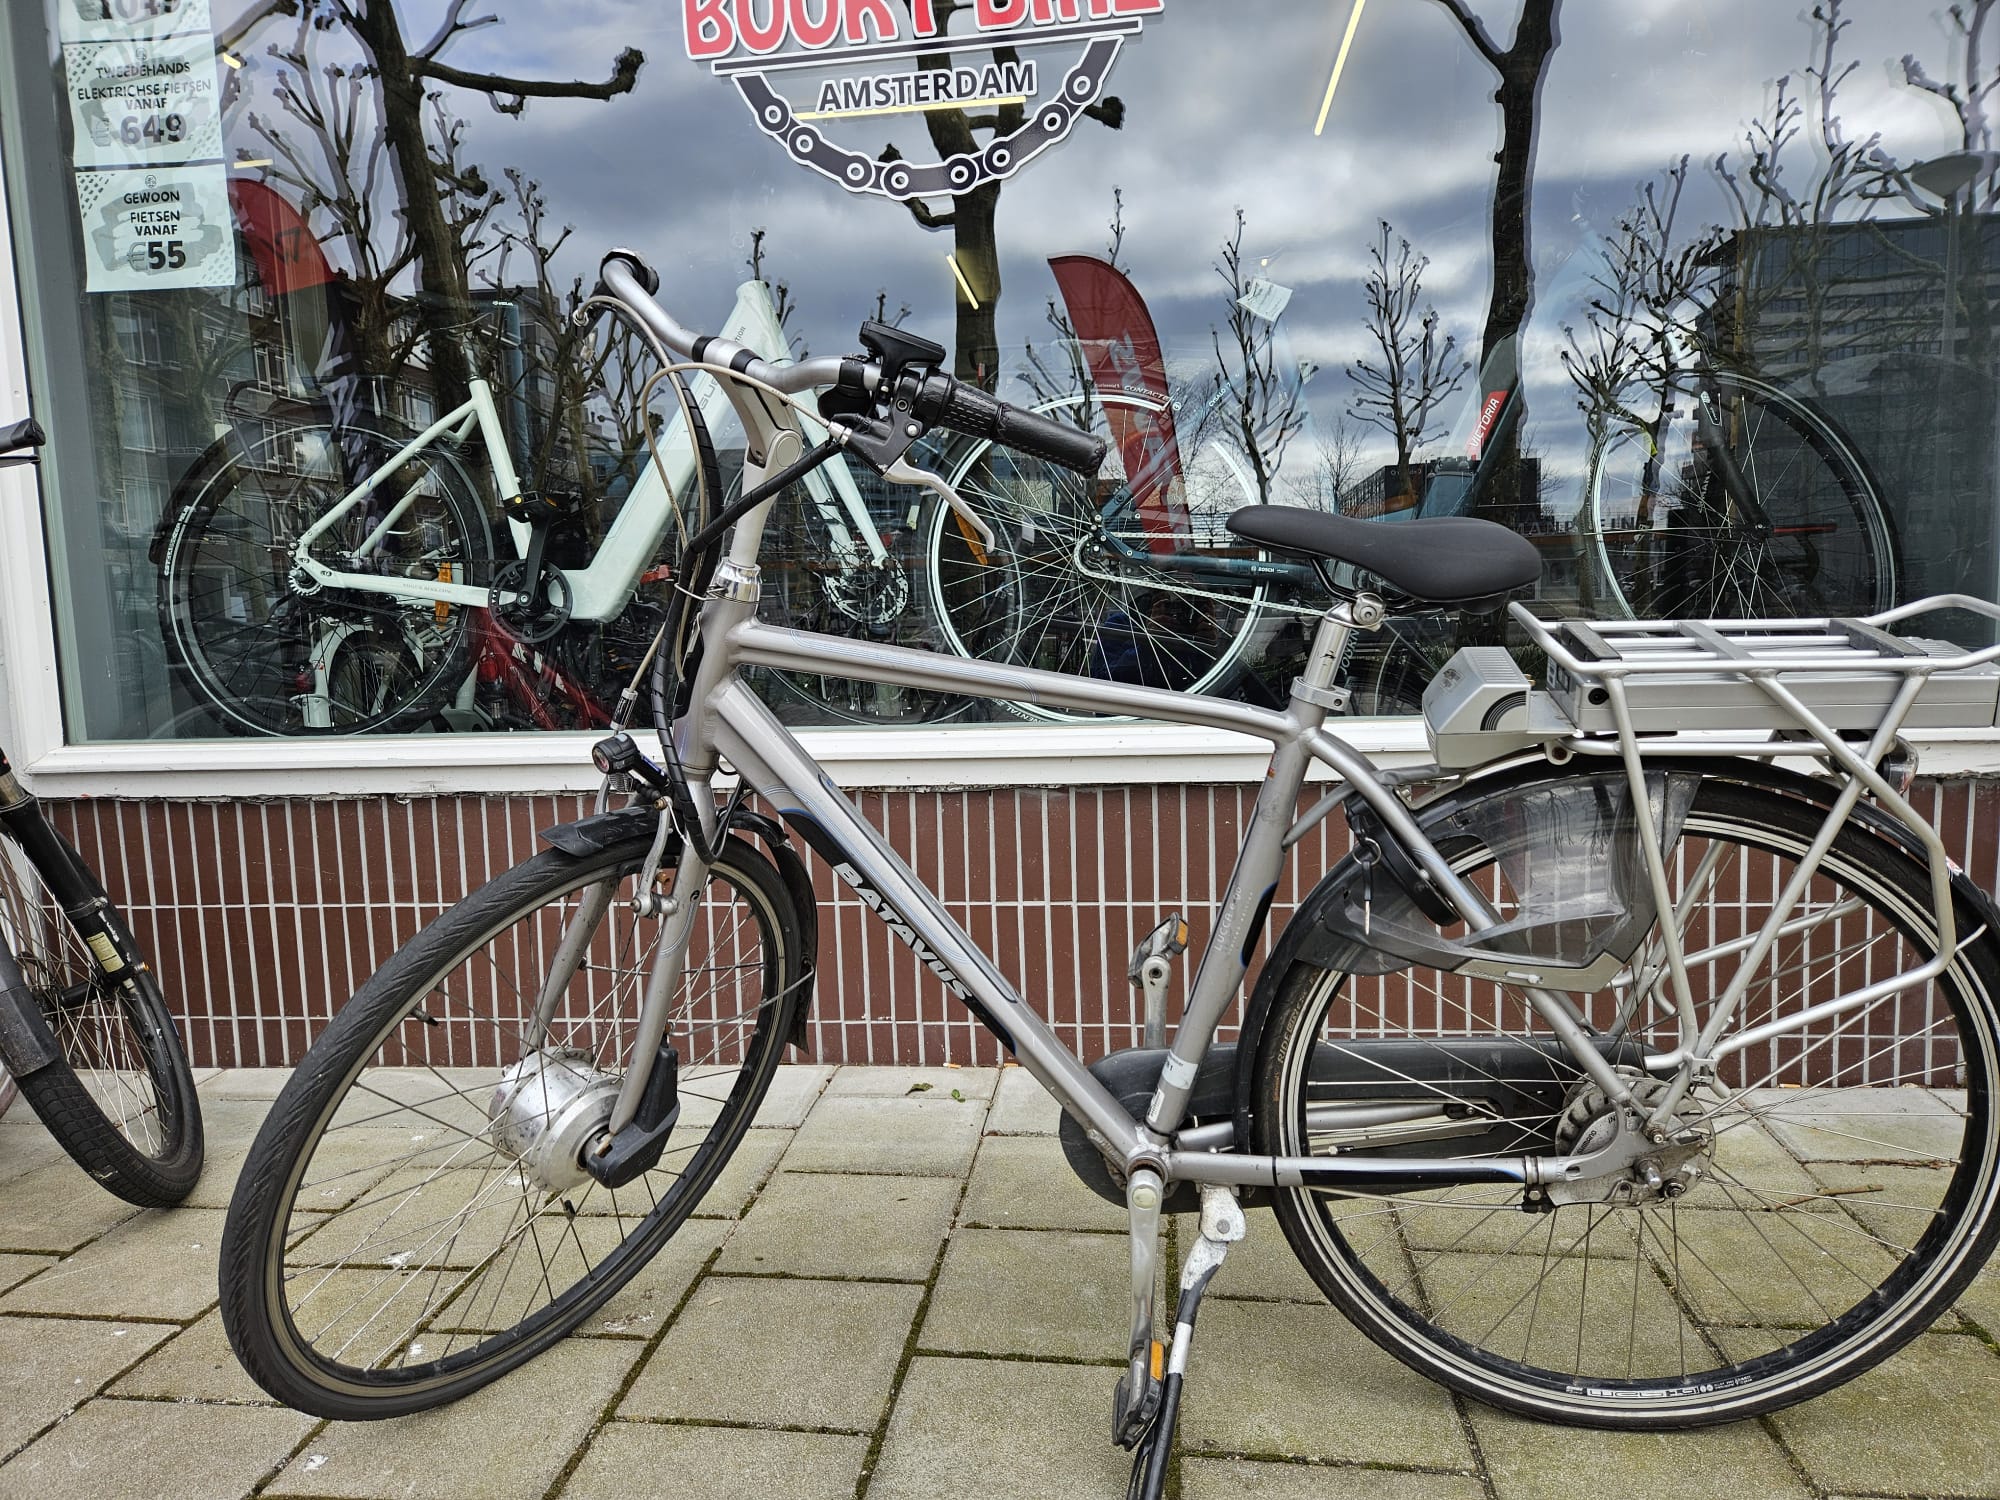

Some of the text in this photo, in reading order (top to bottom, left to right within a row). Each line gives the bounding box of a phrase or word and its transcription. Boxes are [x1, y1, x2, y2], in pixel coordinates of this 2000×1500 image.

[96, 62, 190, 79] TWEEDEHANDS
[163, 79, 212, 96] FIETSEN
[819, 62, 1036, 111] AMSTERDAM
[125, 98, 168, 110] VANAF
[123, 190, 181, 204] GEWOON
[130, 210, 181, 223] FIETSEN
[135, 225, 178, 236] VANAF
[832, 862, 973, 1000] BATAVUS
[1213, 912, 1233, 952] LUCCA
